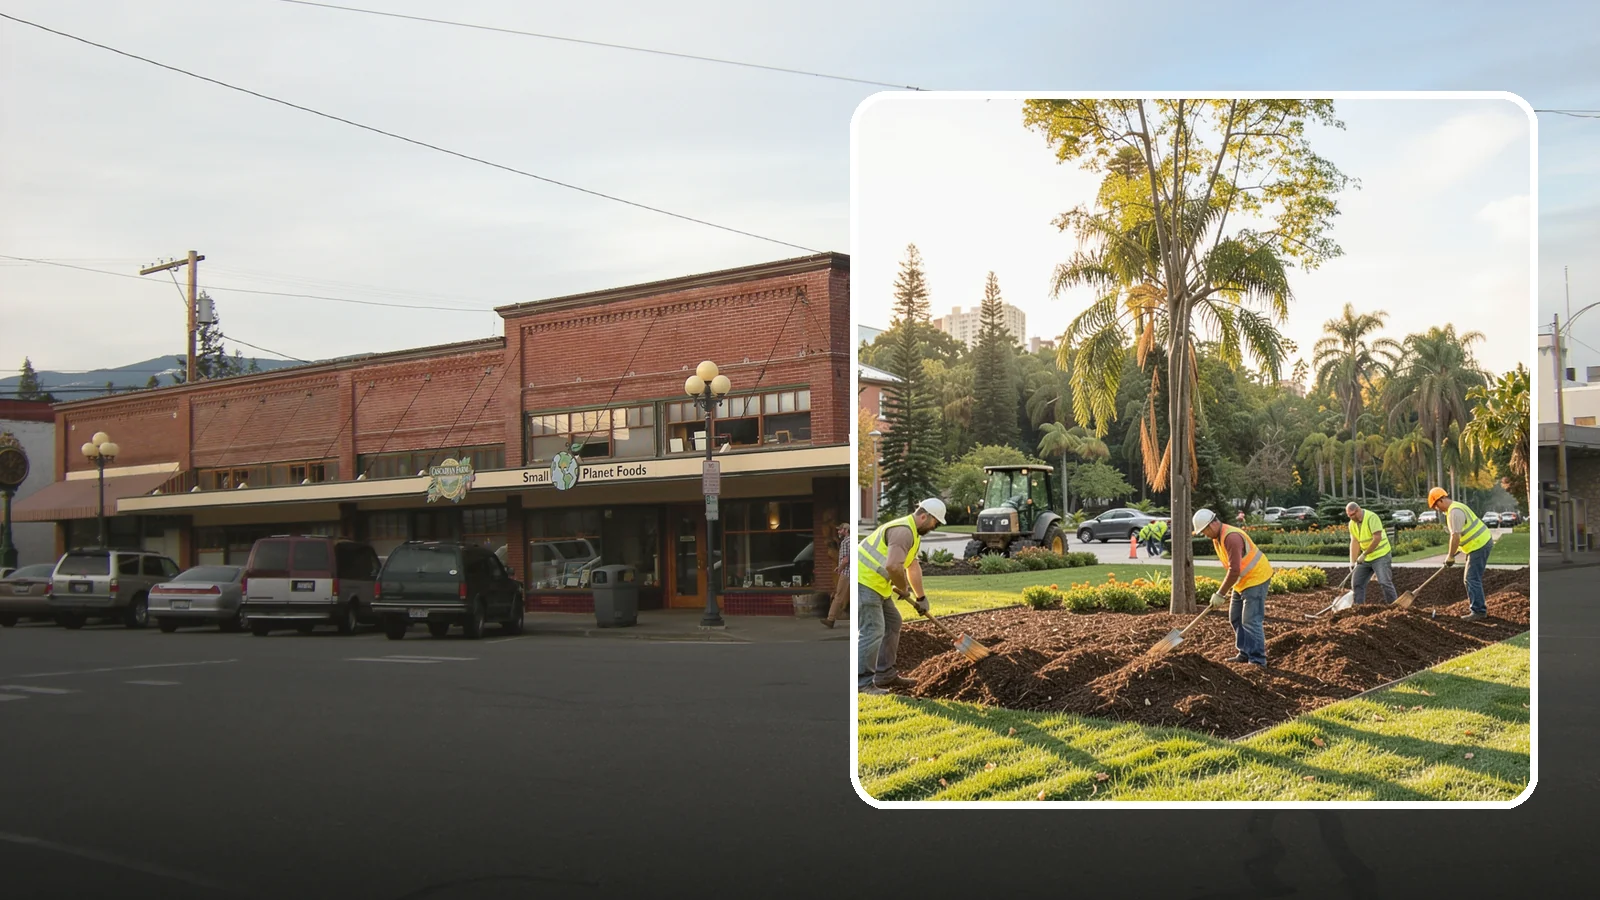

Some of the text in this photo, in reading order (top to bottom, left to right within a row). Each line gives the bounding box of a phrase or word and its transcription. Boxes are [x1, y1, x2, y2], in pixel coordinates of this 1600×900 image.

[523, 464, 647, 483] Small Planet Foods
